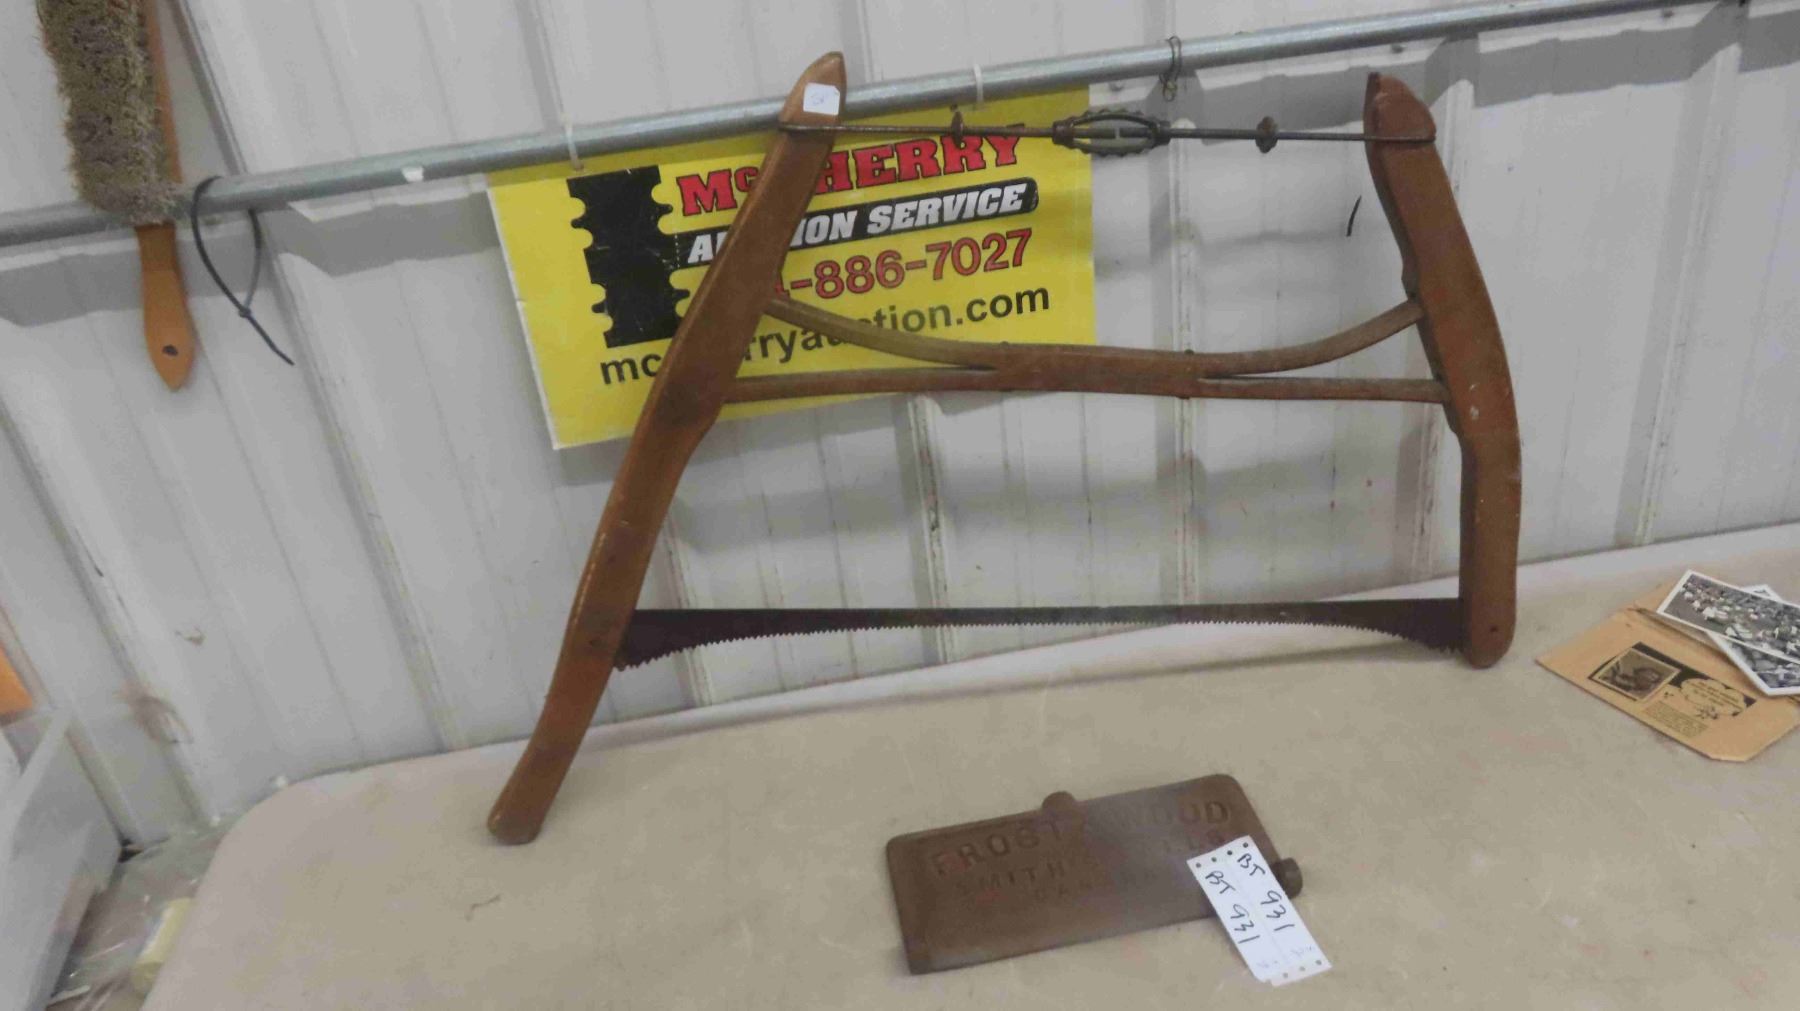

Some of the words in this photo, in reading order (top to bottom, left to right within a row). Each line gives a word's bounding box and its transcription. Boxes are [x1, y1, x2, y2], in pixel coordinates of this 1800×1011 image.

[688, 210, 858, 264] AION
[867, 183, 1027, 235] SERVICE
[931, 814, 1063, 878] FROST
[1205, 870, 1236, 894] BT
[1230, 903, 1260, 944] 931
[1237, 853, 1266, 876] BT
[1260, 890, 1295, 931] 931
